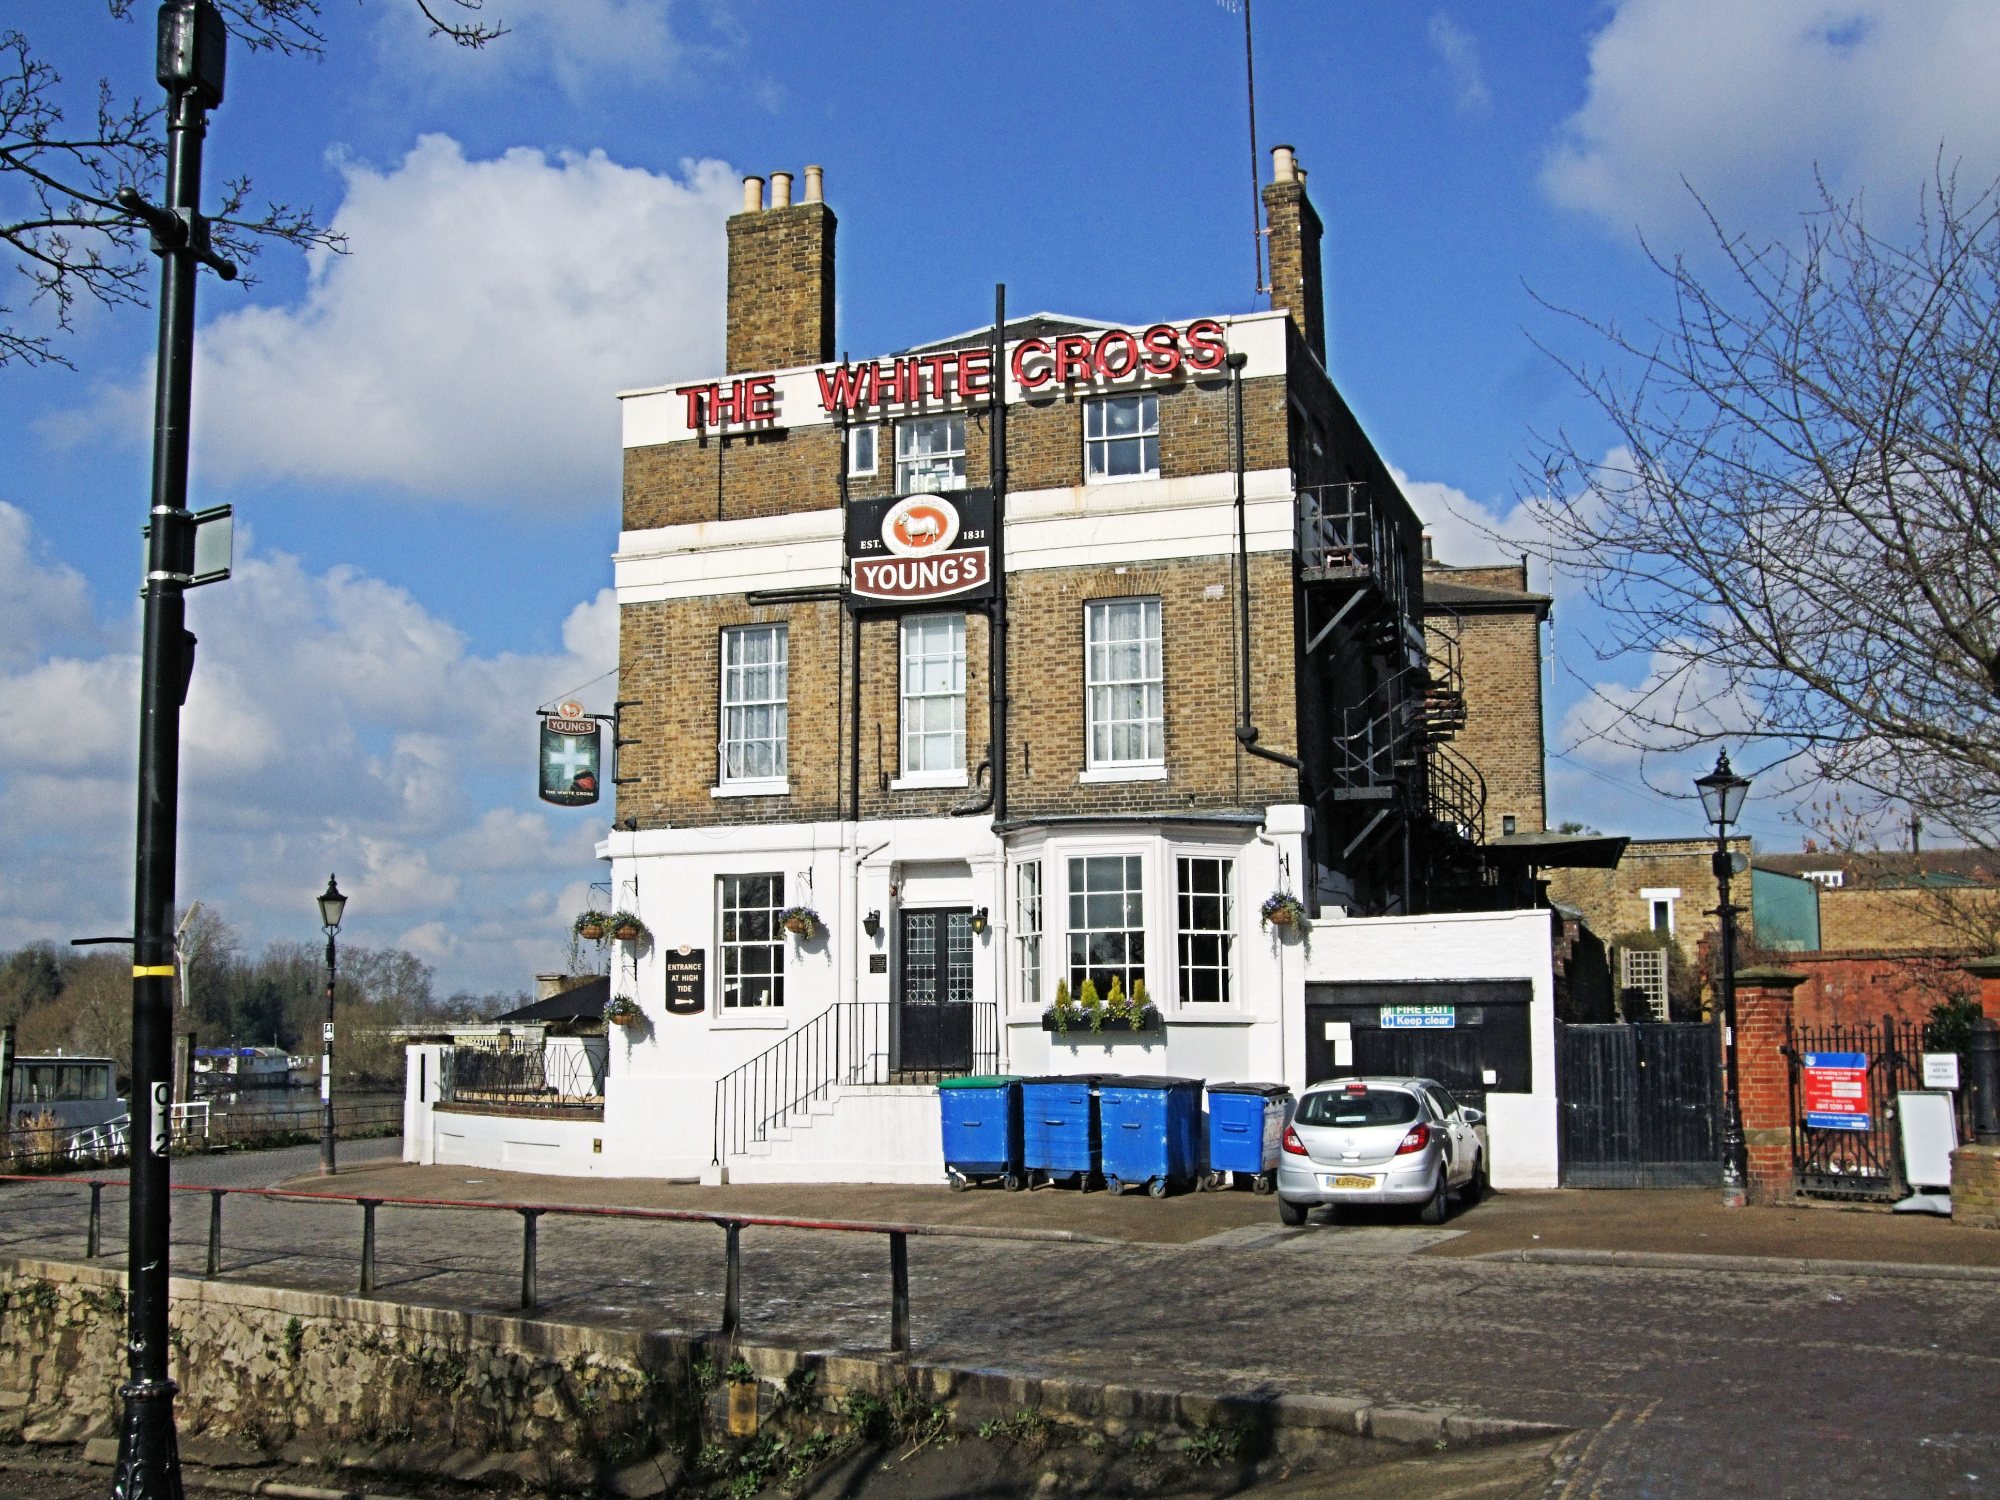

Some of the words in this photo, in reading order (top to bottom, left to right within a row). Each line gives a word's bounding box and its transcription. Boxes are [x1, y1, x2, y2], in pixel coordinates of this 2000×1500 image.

[676, 374, 775, 429] THE
[815, 350, 991, 412] WHITE
[1010, 319, 1226, 388] CROSS
[860, 540, 882, 550] EST.
[963, 529, 985, 540] 1831
[862, 555, 978, 590] YOUNG'S
[551, 720, 592, 732] YOUNG'S
[671, 974, 680, 982] AT
[681, 974, 699, 982] HIGH
[677, 985, 692, 993] TIDE
[1396, 1004, 1422, 1014] FIRE
[1424, 1004, 1448, 1014] EXIT
[1396, 1016, 1423, 1026] Keep
[1424, 1015, 1450, 1025] clear
